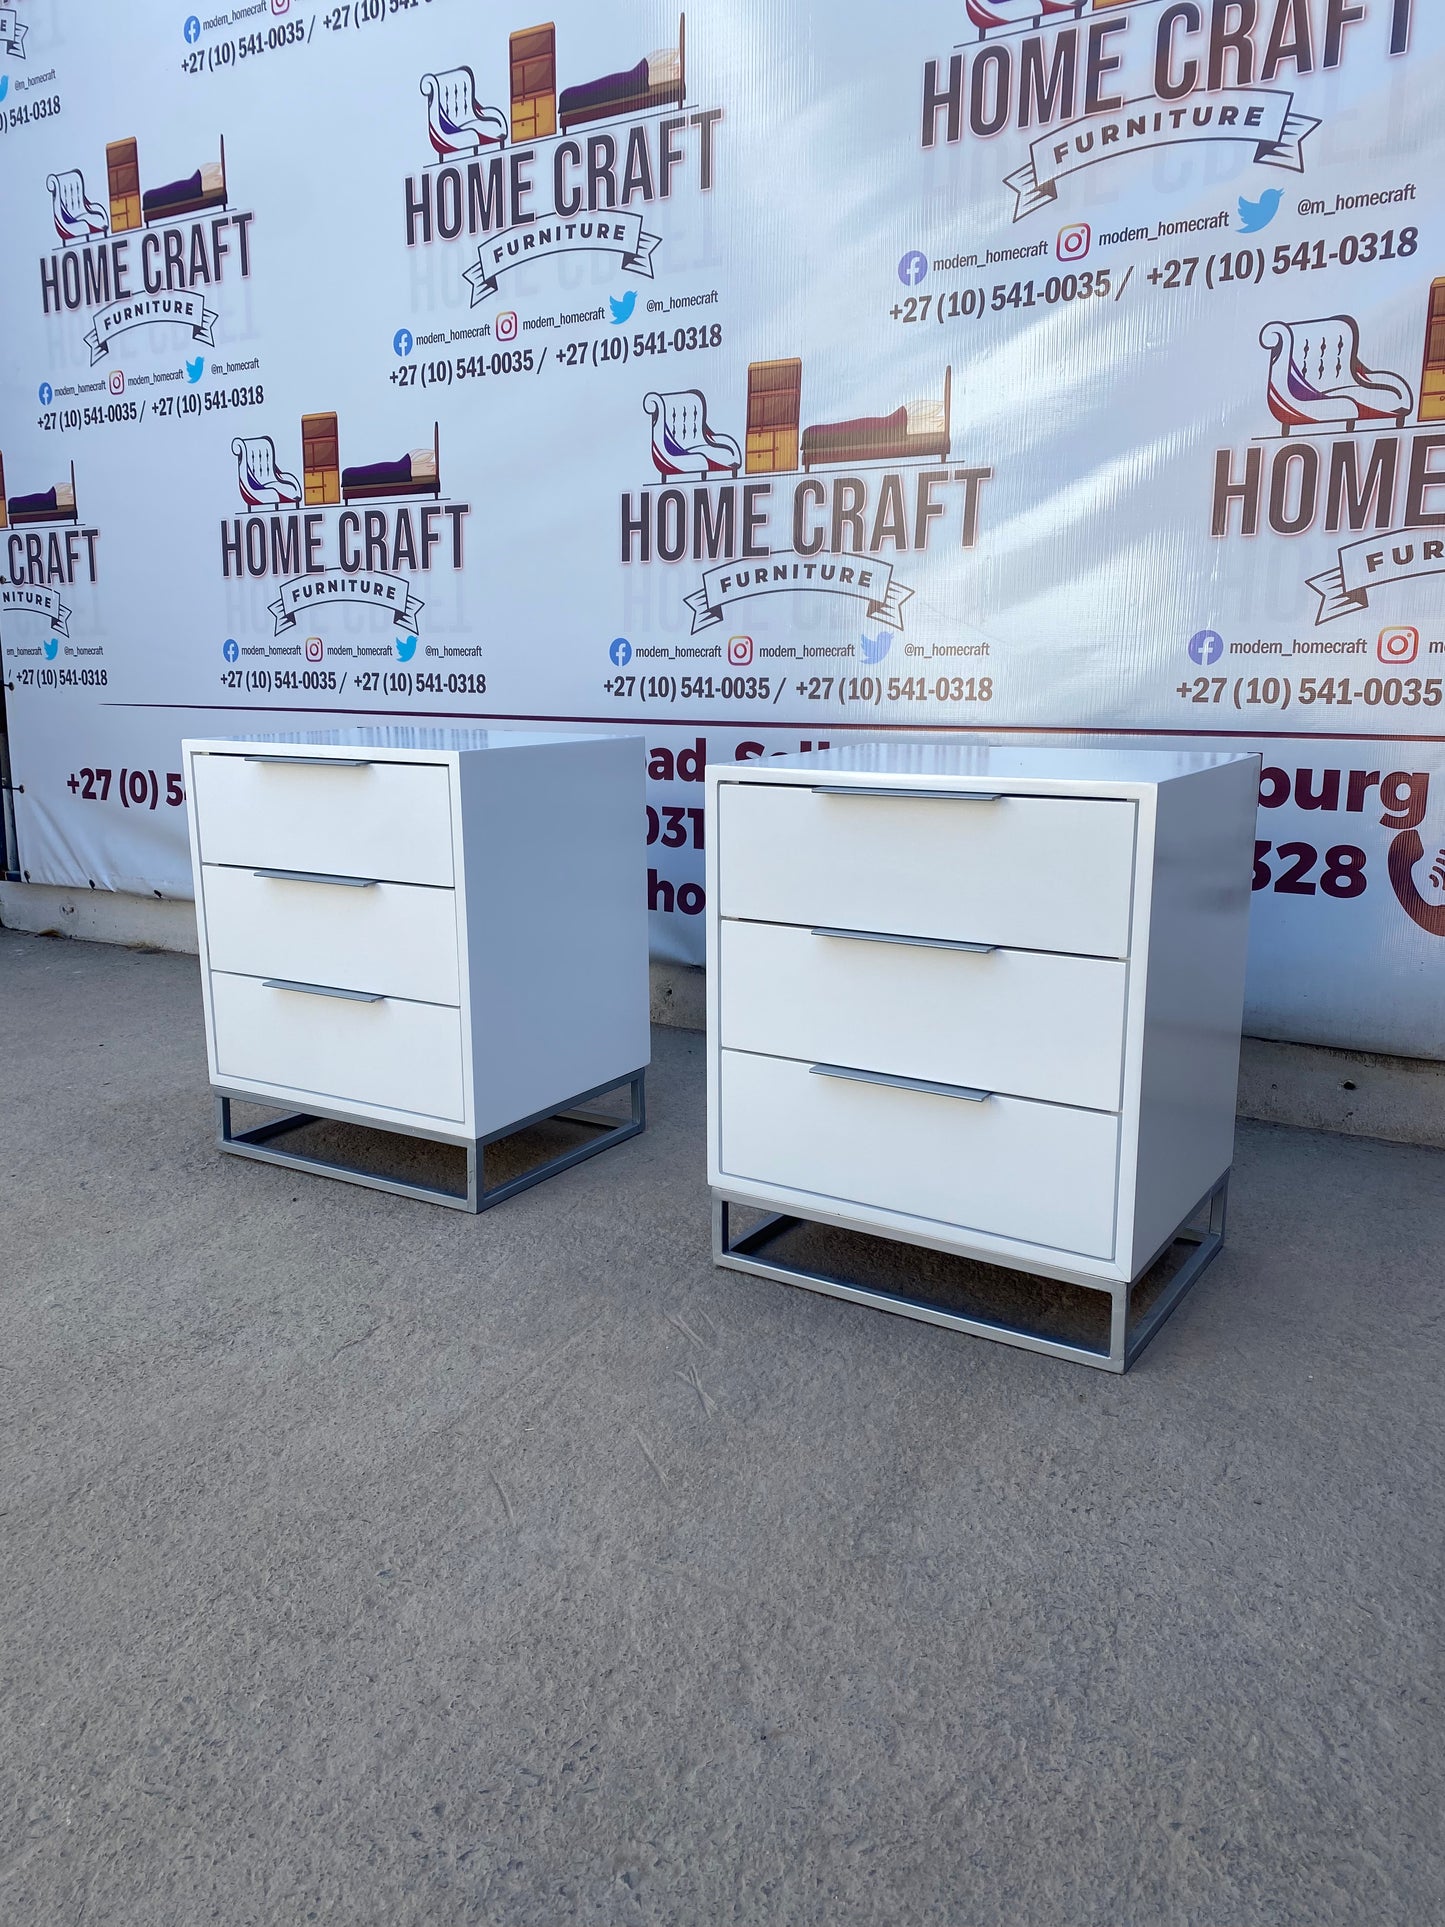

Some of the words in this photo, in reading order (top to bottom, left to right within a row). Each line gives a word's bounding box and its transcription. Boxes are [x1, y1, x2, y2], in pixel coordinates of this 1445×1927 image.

[181, 50, 205, 73] +27
[208, 41, 235, 72] (10)
[238, 20, 305, 59] 541-0035
[323, 5, 351, 31] +27
[920, 17, 1127, 148] HOME
[9, 95, 61, 127] 541-0318
[1053, 106, 1265, 164] FURNITURE
[404, 150, 535, 246] HOME
[553, 107, 723, 217] CRAFT
[1297, 184, 1416, 216] @m_homecraft
[40, 240, 132, 313] HOME
[142, 212, 254, 294] CRAFT
[493, 222, 626, 263] FURNITURE
[889, 293, 932, 324] +27
[937, 287, 986, 321] (10)
[990, 268, 1112, 311] 541-0035
[1147, 257, 1200, 289] +27
[1205, 248, 1264, 290] (10)
[1271, 226, 1419, 273] 541-0318
[104, 300, 195, 331] FURNITURE
[646, 290, 719, 313] @m_homecraft
[389, 364, 418, 387] +27
[420, 359, 453, 388] (10)
[456, 349, 534, 379] 541-0035
[556, 342, 588, 366] +27
[592, 337, 630, 367] (10)
[633, 323, 723, 357] 541-0318
[37, 412, 57, 431] +27
[59, 408, 82, 432] (10)
[83, 400, 137, 424] 541-0035
[151, 397, 174, 420] +27
[176, 392, 201, 418] (10)
[204, 385, 264, 412] 541-0318
[1211, 435, 1445, 536] HOME
[620, 484, 771, 562] HOME
[794, 467, 992, 556] CRAFT
[7, 529, 98, 586] CRAFT
[221, 514, 324, 577] HOME
[339, 505, 469, 573] CRAFT
[292, 578, 397, 602] FURNITURE
[721, 564, 873, 594] FURNITURE
[425, 644, 483, 659] @m_homecraft
[904, 642, 990, 658] @m_homecraft
[16, 669, 34, 685] +27
[37, 669, 57, 688] (10)
[59, 669, 108, 686] 541-0318
[220, 672, 243, 689] +27
[245, 671, 271, 693] (10)
[274, 671, 337, 690] 541-0035
[354, 673, 380, 692] +27
[383, 672, 412, 695] (10)
[416, 673, 486, 694] 541-0318
[604, 676, 636, 697] +27
[640, 675, 677, 702] (10)
[680, 676, 770, 699] 541-0035
[796, 677, 834, 700] +27
[838, 676, 882, 705] (10)
[886, 677, 993, 702] 541-0318
[1176, 677, 1228, 703] +27
[1234, 677, 1292, 710] (10)
[1298, 677, 1443, 706] 541-0035
[67, 767, 112, 801] +27
[119, 768, 158, 811] (0)
